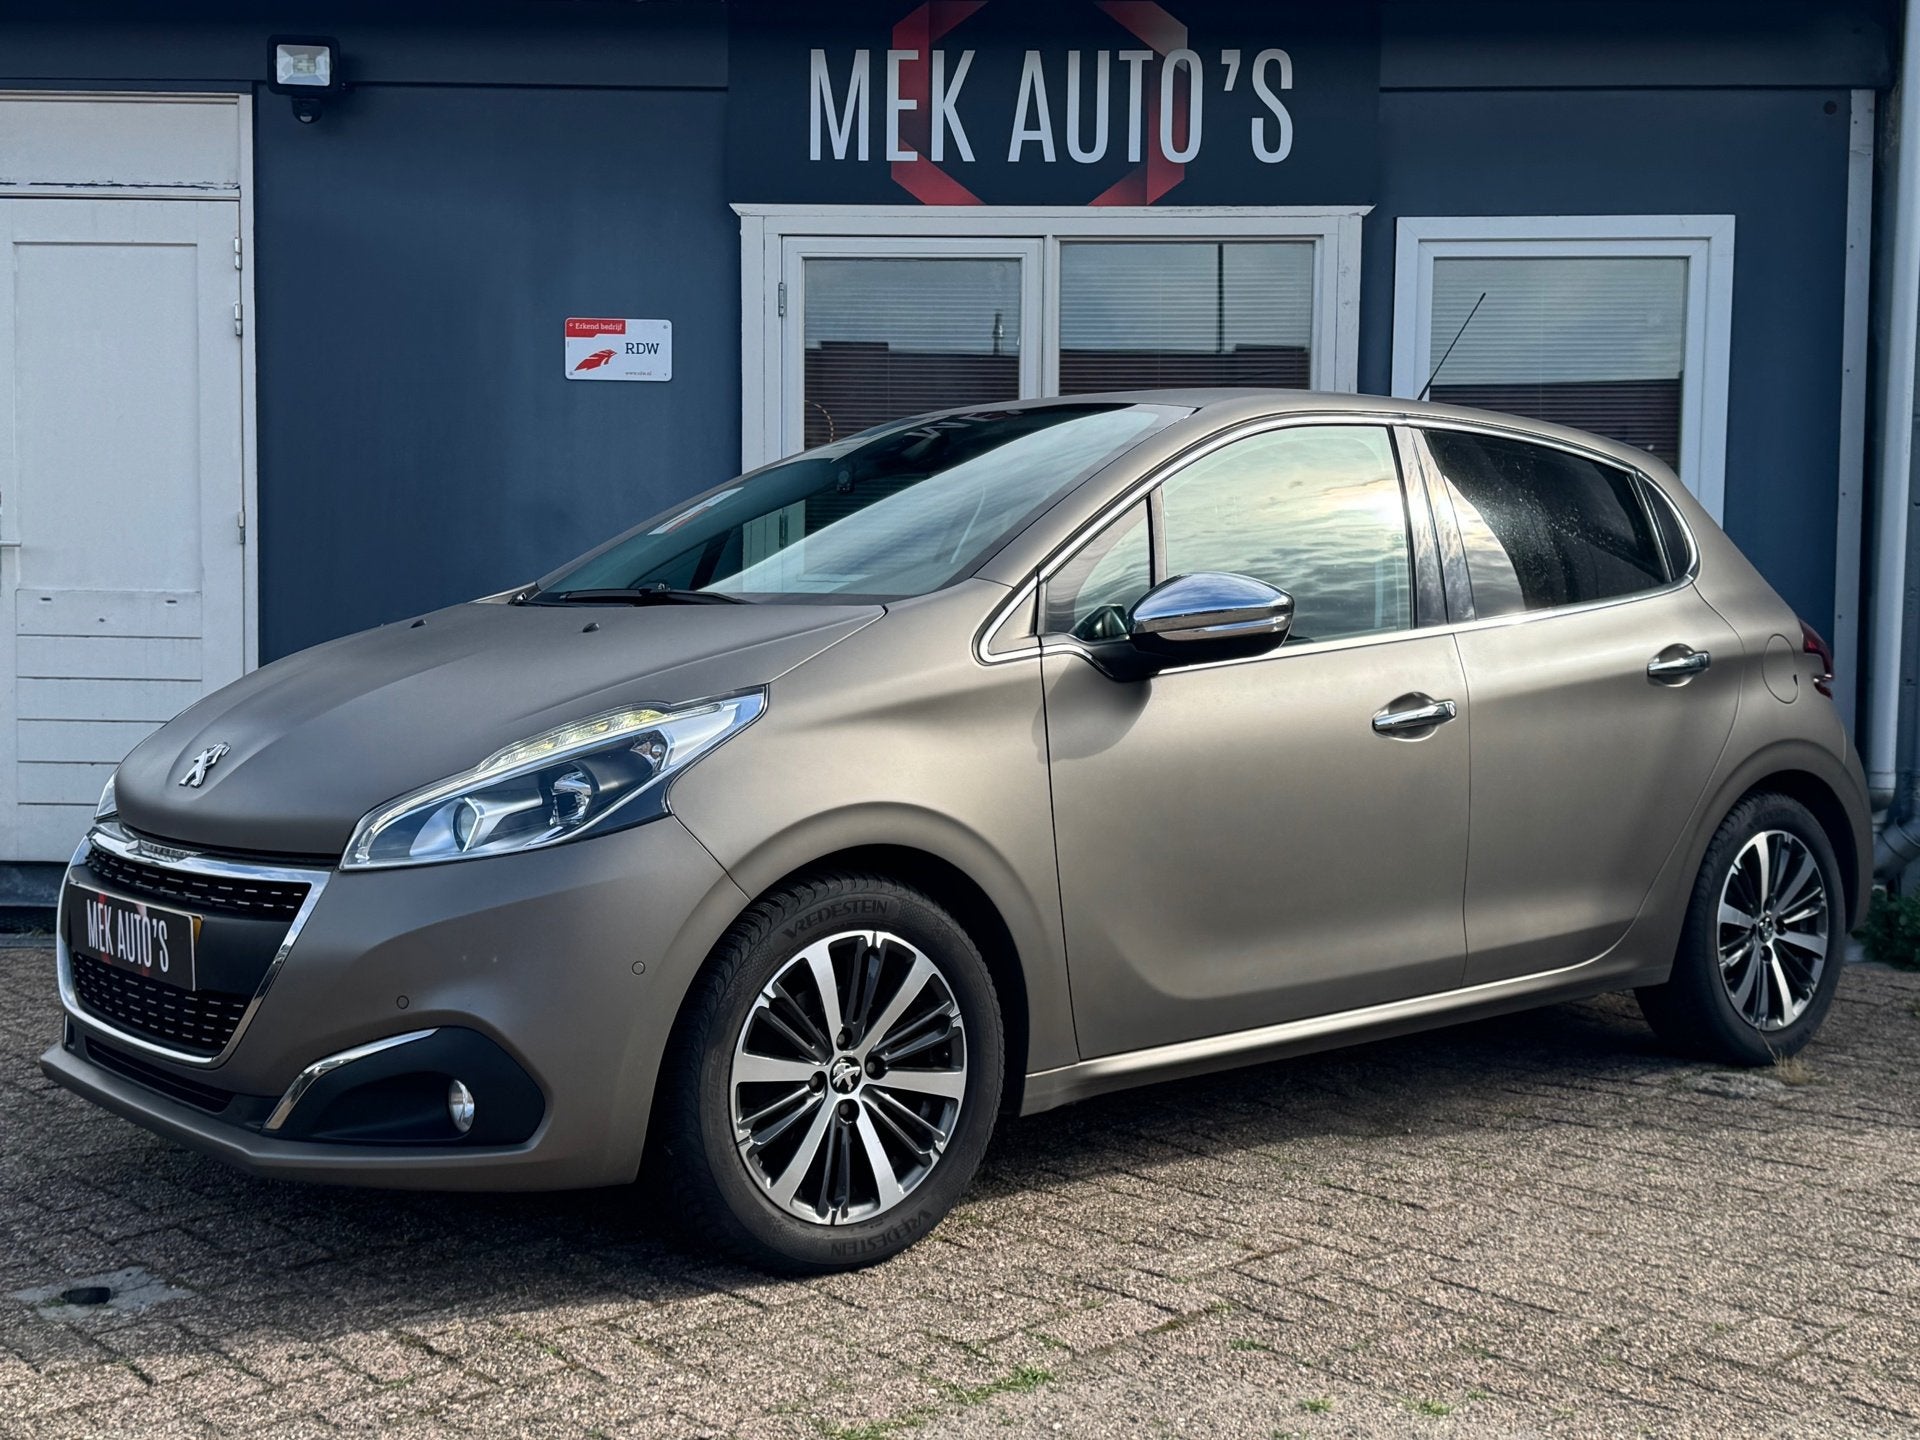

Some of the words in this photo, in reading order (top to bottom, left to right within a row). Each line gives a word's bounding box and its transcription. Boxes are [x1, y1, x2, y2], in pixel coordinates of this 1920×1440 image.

[809, 48, 976, 162] MEK
[1007, 48, 1294, 164] AUTO'S
[575, 322, 599, 330] Erkend
[601, 322, 623, 331] bedrijf
[625, 342, 660, 355] RDW
[86, 898, 114, 956] MEK
[117, 908, 170, 973] AUTO'S
[782, 900, 888, 938] VREDESTEIN
[830, 1208, 933, 1258] VREDESTEIN
